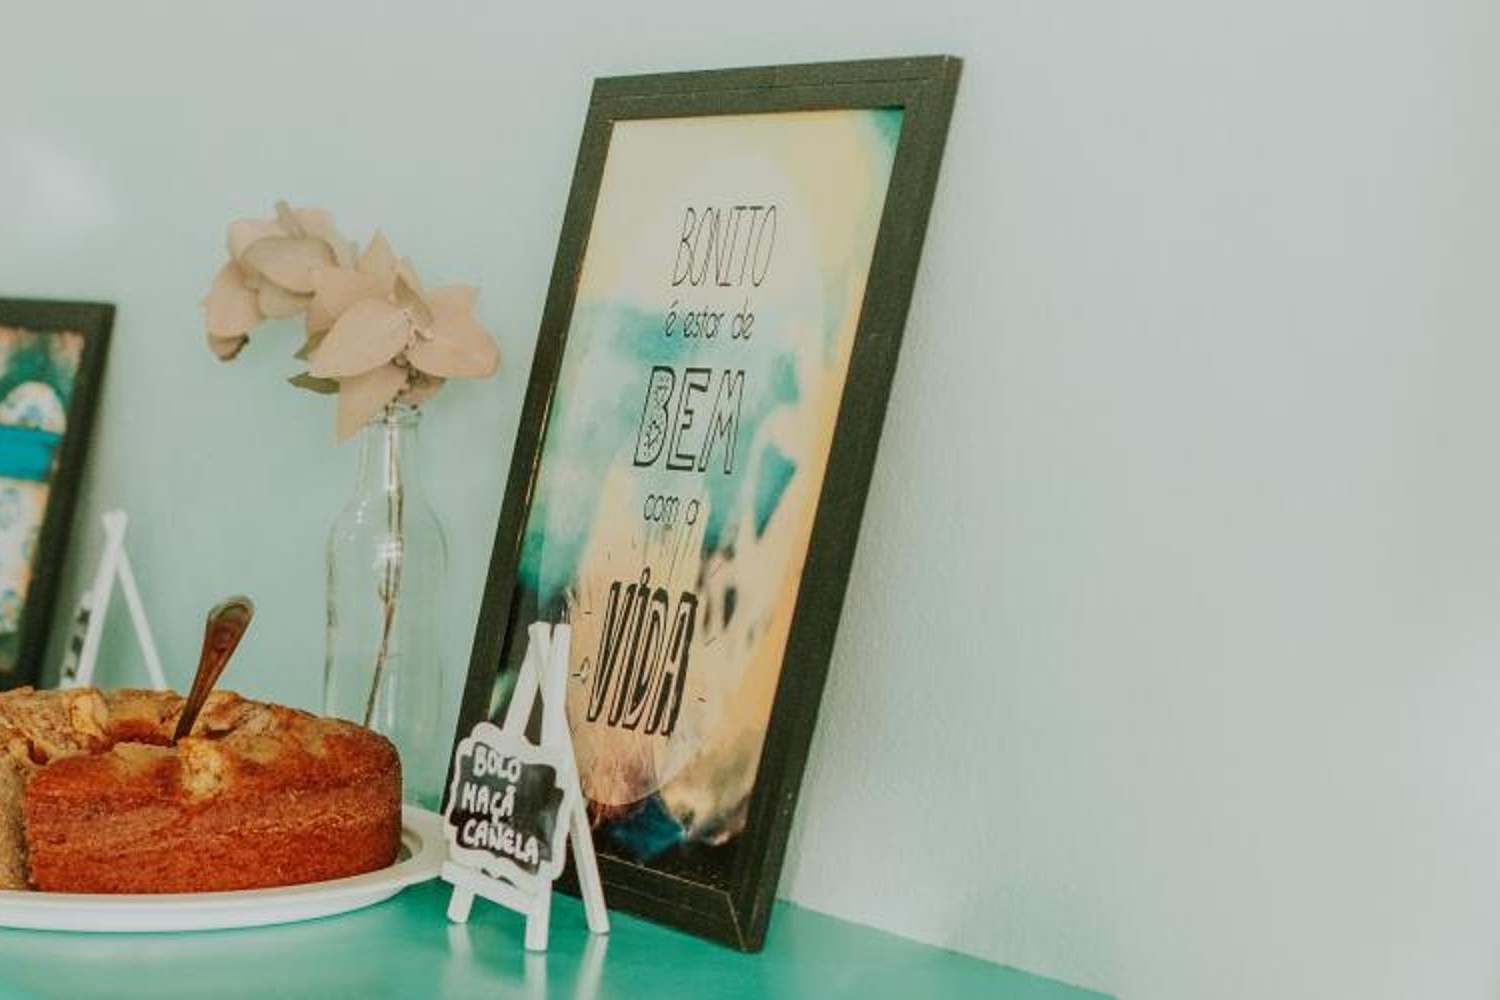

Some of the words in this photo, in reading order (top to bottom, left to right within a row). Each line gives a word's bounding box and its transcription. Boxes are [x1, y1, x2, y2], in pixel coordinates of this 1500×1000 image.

[671, 204, 777, 287] BONITO
[665, 298, 679, 337] é
[683, 305, 725, 338] estar
[731, 295, 755, 339] de
[632, 364, 745, 475] BEM
[643, 493, 680, 522] com
[586, 567, 699, 736] VIDA
[472, 745, 522, 783] BOLO
[462, 818, 540, 865] CANELA
